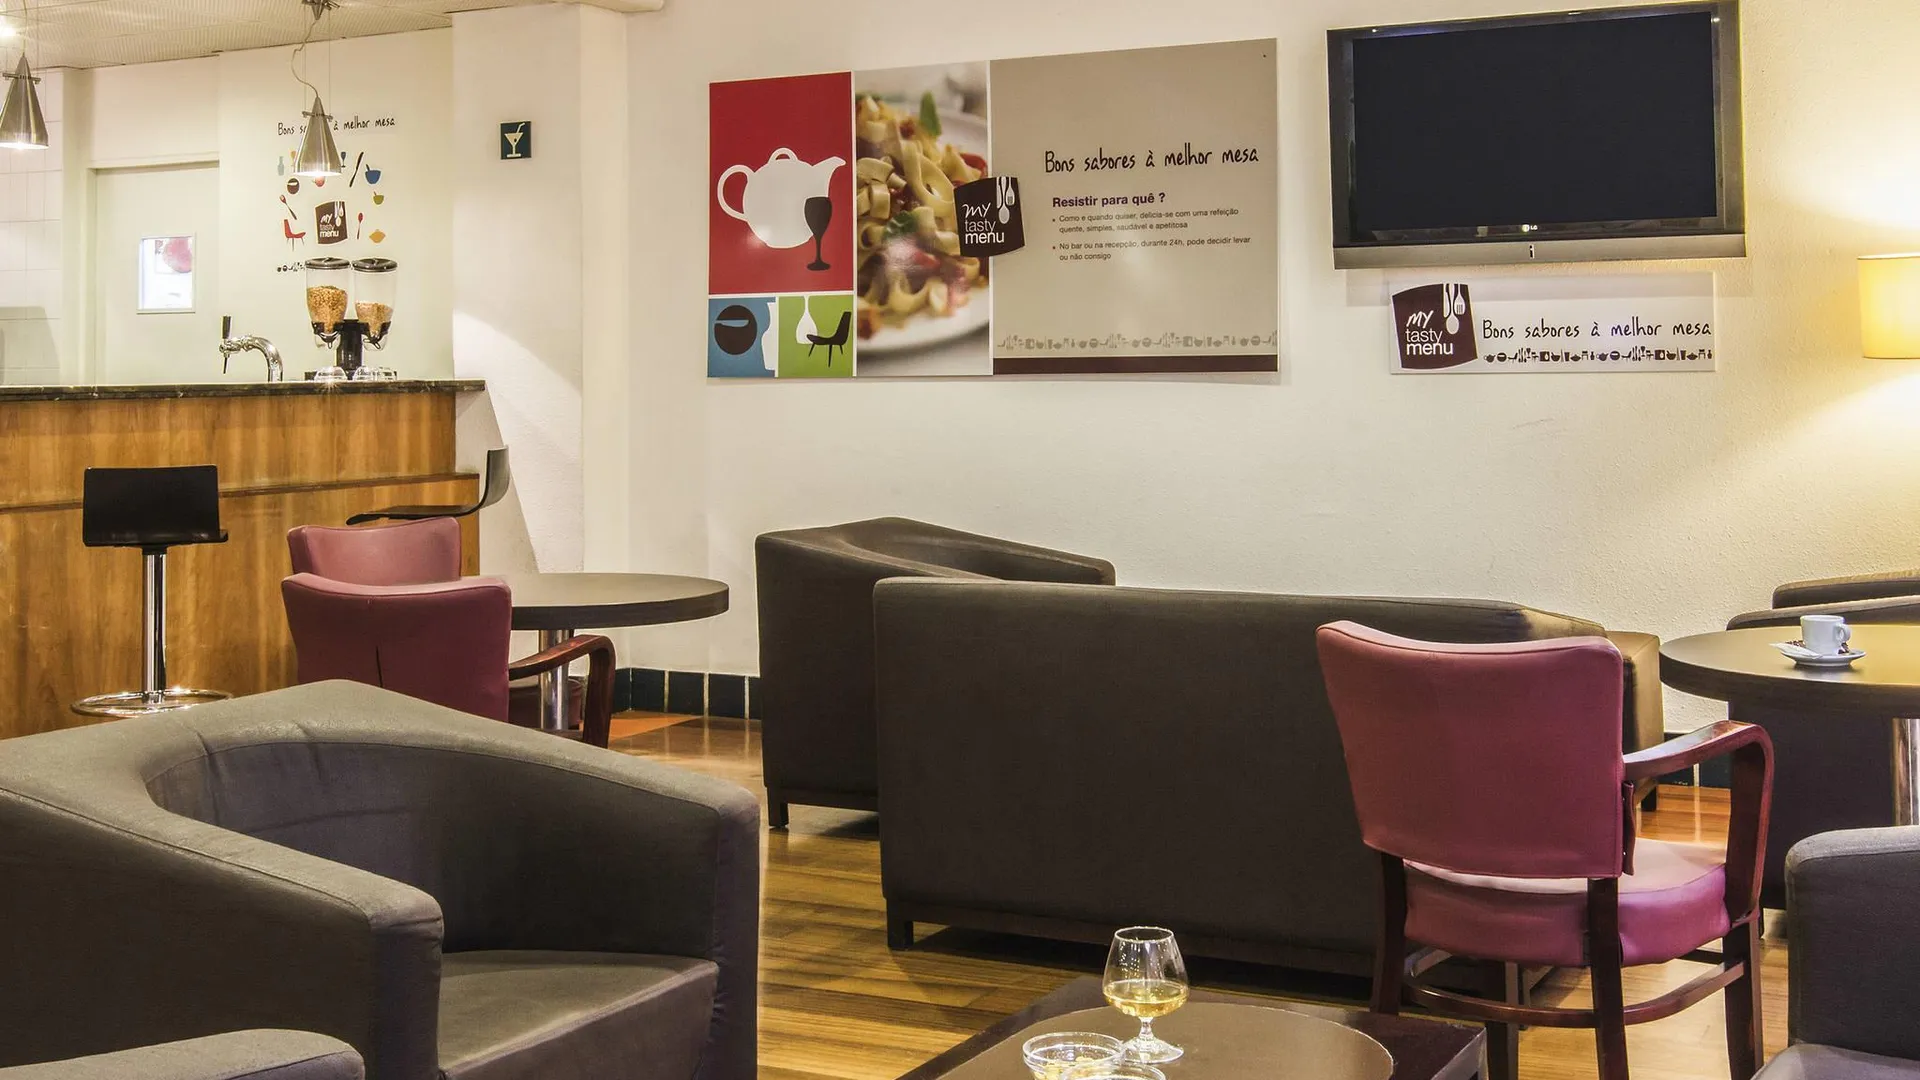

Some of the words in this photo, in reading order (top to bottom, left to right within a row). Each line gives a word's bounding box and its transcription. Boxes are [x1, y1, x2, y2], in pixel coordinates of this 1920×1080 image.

[277, 122, 294, 136] Bons
[333, 120, 339, 131] à
[343, 115, 370, 130] melhor
[375, 117, 396, 127] mesa
[1045, 150, 1075, 173] Bons
[1084, 147, 1136, 171] sabores
[1145, 150, 1155, 168] à
[1164, 142, 1213, 167] melhor
[1222, 147, 1259, 164] mesa
[1052, 195, 1098, 208] Resistir
[1101, 196, 1128, 208] para
[1131, 192, 1155, 206] quê
[1158, 192, 1166, 203] ?
[1087, 213, 1113, 222] quando
[1210, 208, 1239, 217] refeição
[320, 223, 335, 231] tasty
[964, 218, 996, 233] tasty
[1155, 221, 1188, 230] apetitosa
[319, 229, 339, 238] menu
[965, 232, 1005, 244] menu
[1071, 241, 1082, 249] bar
[1141, 238, 1168, 247] durante
[1186, 238, 1205, 246] pode
[1207, 236, 1231, 245] decidir
[1233, 235, 1251, 244] levar
[1084, 252, 1111, 260] consigo
[1482, 319, 1515, 340] Bons
[1525, 318, 1580, 338] sabores
[1590, 321, 1601, 337] à
[1610, 316, 1662, 337] melhor
[1672, 322, 1712, 336] mesa
[1405, 327, 1443, 345] tasty
[1406, 342, 1454, 356] menu
